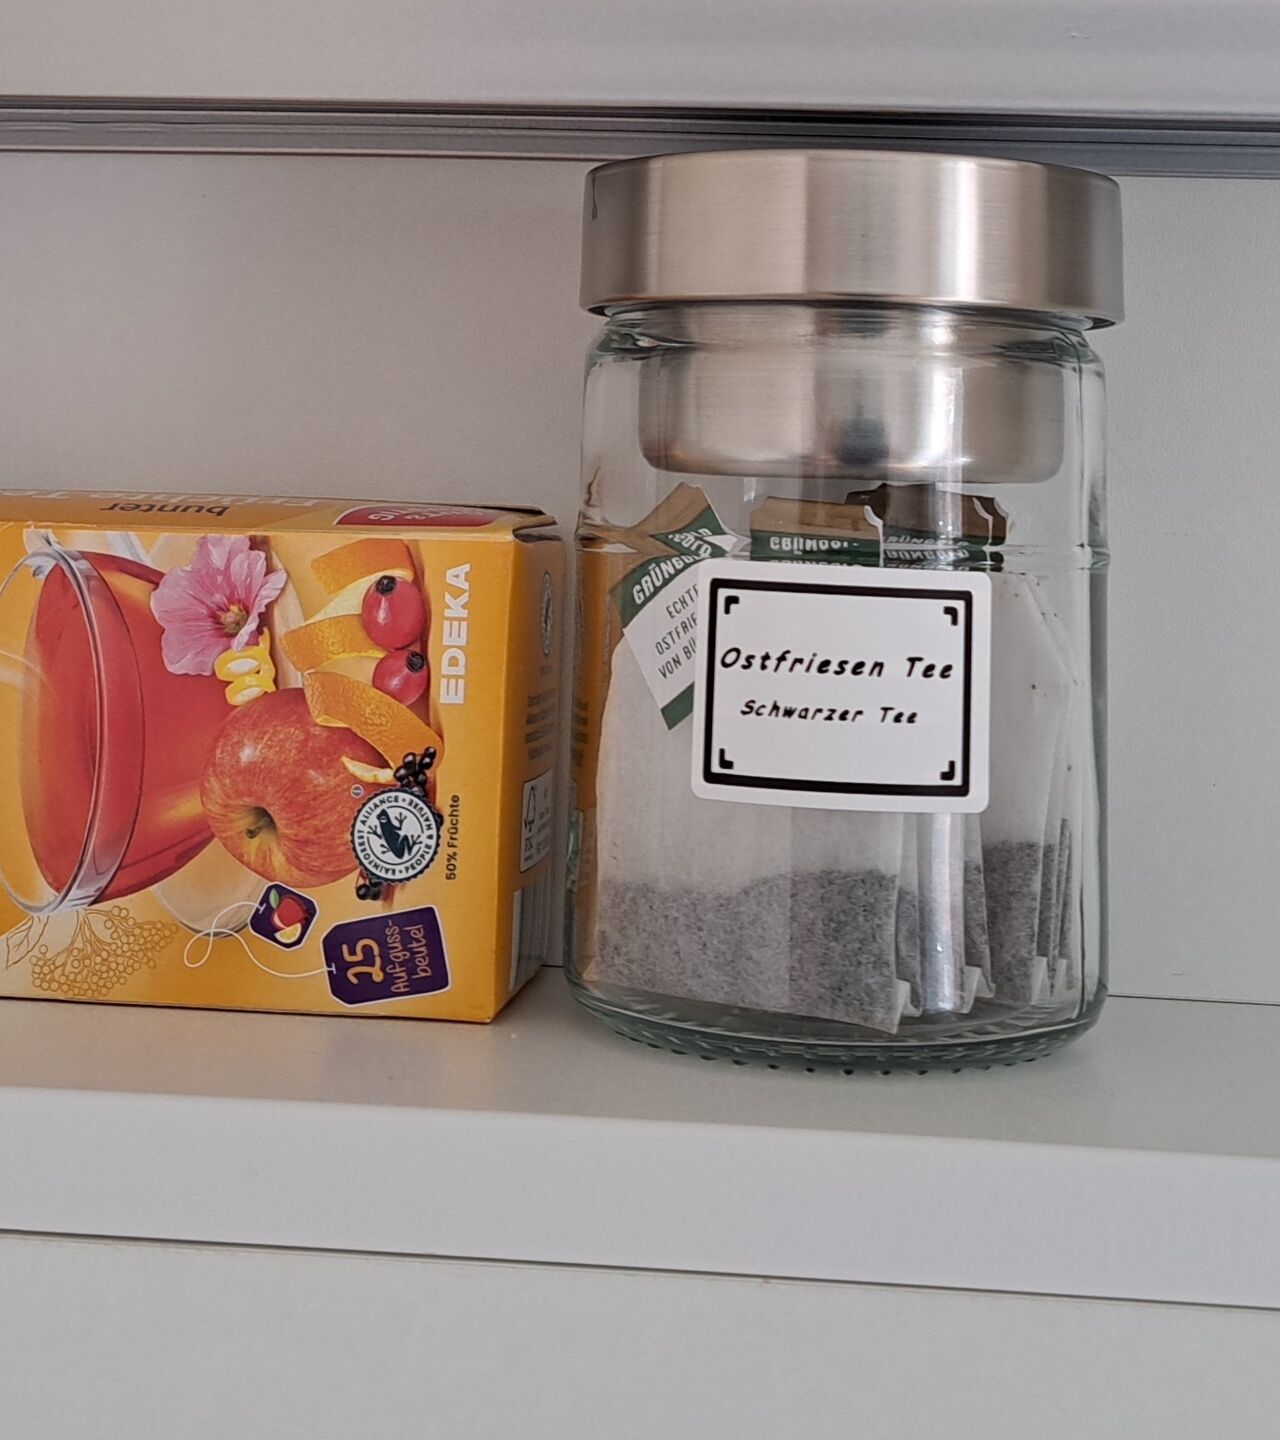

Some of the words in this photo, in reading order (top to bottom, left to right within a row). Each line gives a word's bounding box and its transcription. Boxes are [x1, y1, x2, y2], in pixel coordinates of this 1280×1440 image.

[99, 503, 230, 516] bunter
[439, 563, 472, 704] EDEKA
[658, 654, 683, 680] VON
[719, 646, 885, 678] Ostfriesen
[905, 656, 954, 679] Tee
[740, 698, 865, 722] Schwarzer
[880, 706, 919, 724] Tee
[445, 851, 458, 880] 50%
[346, 936, 381, 985] 25
[388, 918, 412, 994] Aufguss-
[411, 922, 432, 980] beutel
